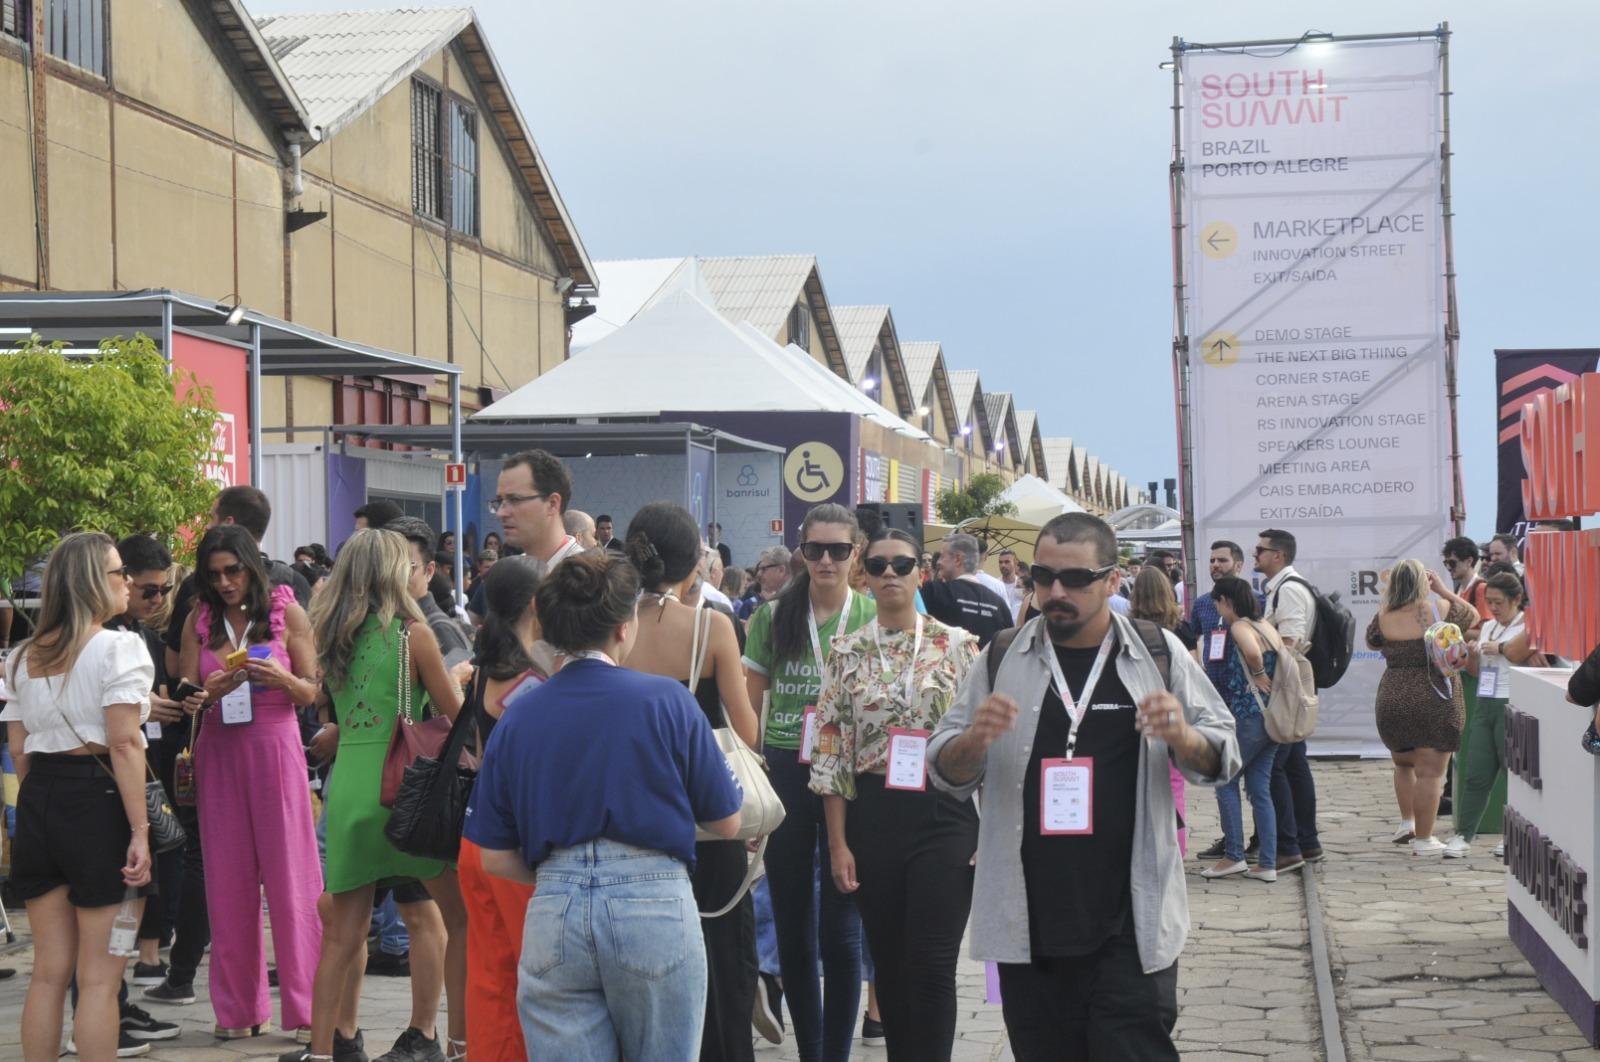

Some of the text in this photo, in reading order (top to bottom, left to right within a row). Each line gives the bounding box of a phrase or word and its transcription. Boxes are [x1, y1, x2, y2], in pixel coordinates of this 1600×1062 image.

[1201, 69, 1324, 100] SOUTH
[1202, 96, 1348, 128] SUMMIT
[1202, 139, 1271, 157] BRAZIL
[1202, 157, 1349, 178] PORTO ALEGRE
[1253, 214, 1425, 239] MARKETPLACE
[1253, 244, 1406, 261] INNOVATION STREET
[1253, 268, 1337, 284] EXIT/SAÍDA
[1255, 326, 1352, 342] DEMO STAGE
[1256, 346, 1407, 364] THE NEXT BIG THING
[1256, 370, 1370, 386] CORNER STAGE
[1256, 393, 1361, 408] ARENA STAGE
[1257, 413, 1426, 431] RS INNOVATION STAGE
[1258, 436, 1400, 453] SPEAKERS LOUNGE
[1258, 460, 1371, 476] MEETING AREA
[726, 488, 770, 498] banrisul
[1259, 481, 1415, 497] CAIS EMBARCADERO
[1260, 504, 1344, 520] EXIT/SAÍDA
[776, 679, 820, 696] horiz
